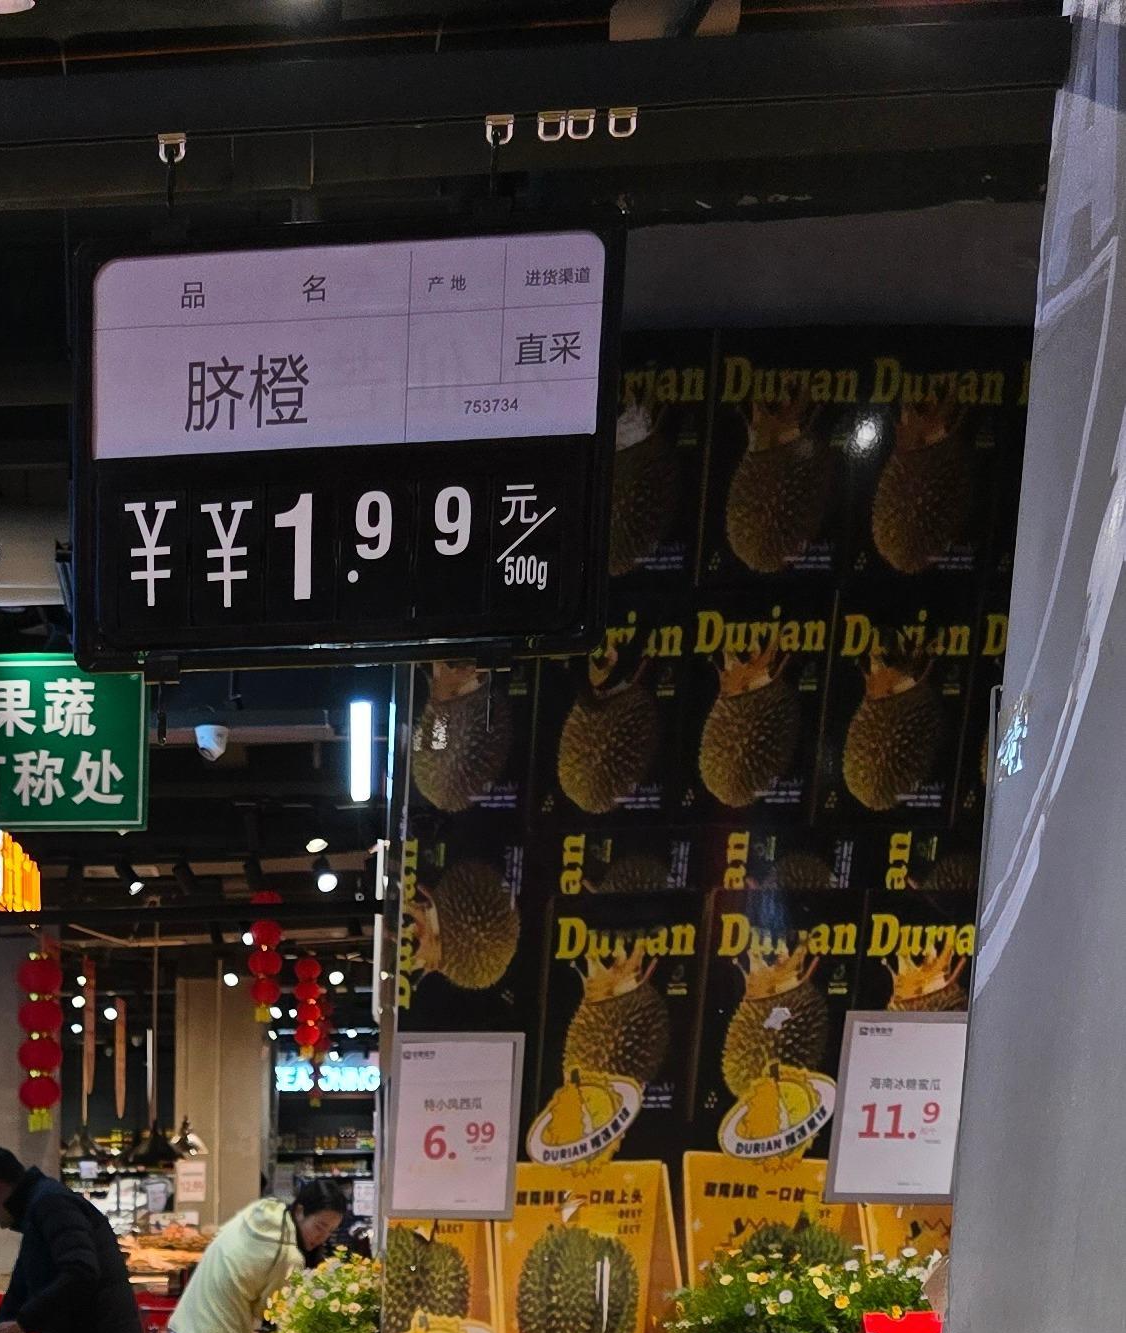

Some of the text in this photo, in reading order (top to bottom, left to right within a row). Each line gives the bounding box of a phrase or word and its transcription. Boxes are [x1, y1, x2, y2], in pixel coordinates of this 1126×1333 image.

[428, 274, 466, 292] 产地
[525, 266, 591, 288] 进货渠道
[515, 332, 582, 367] 直采
[184, 354, 310, 433] 脐橙
[621, 361, 706, 405] rian
[464, 398, 519, 415] 753734
[694, 605, 826, 656] Durian
[867, 912, 975, 957] Duria
[858, 1101, 941, 1140] 11.9
[424, 1121, 495, 1160] 6.99
[542, 1143, 588, 1161] DURIAN
[735, 1138, 782, 1154] DURIAN
